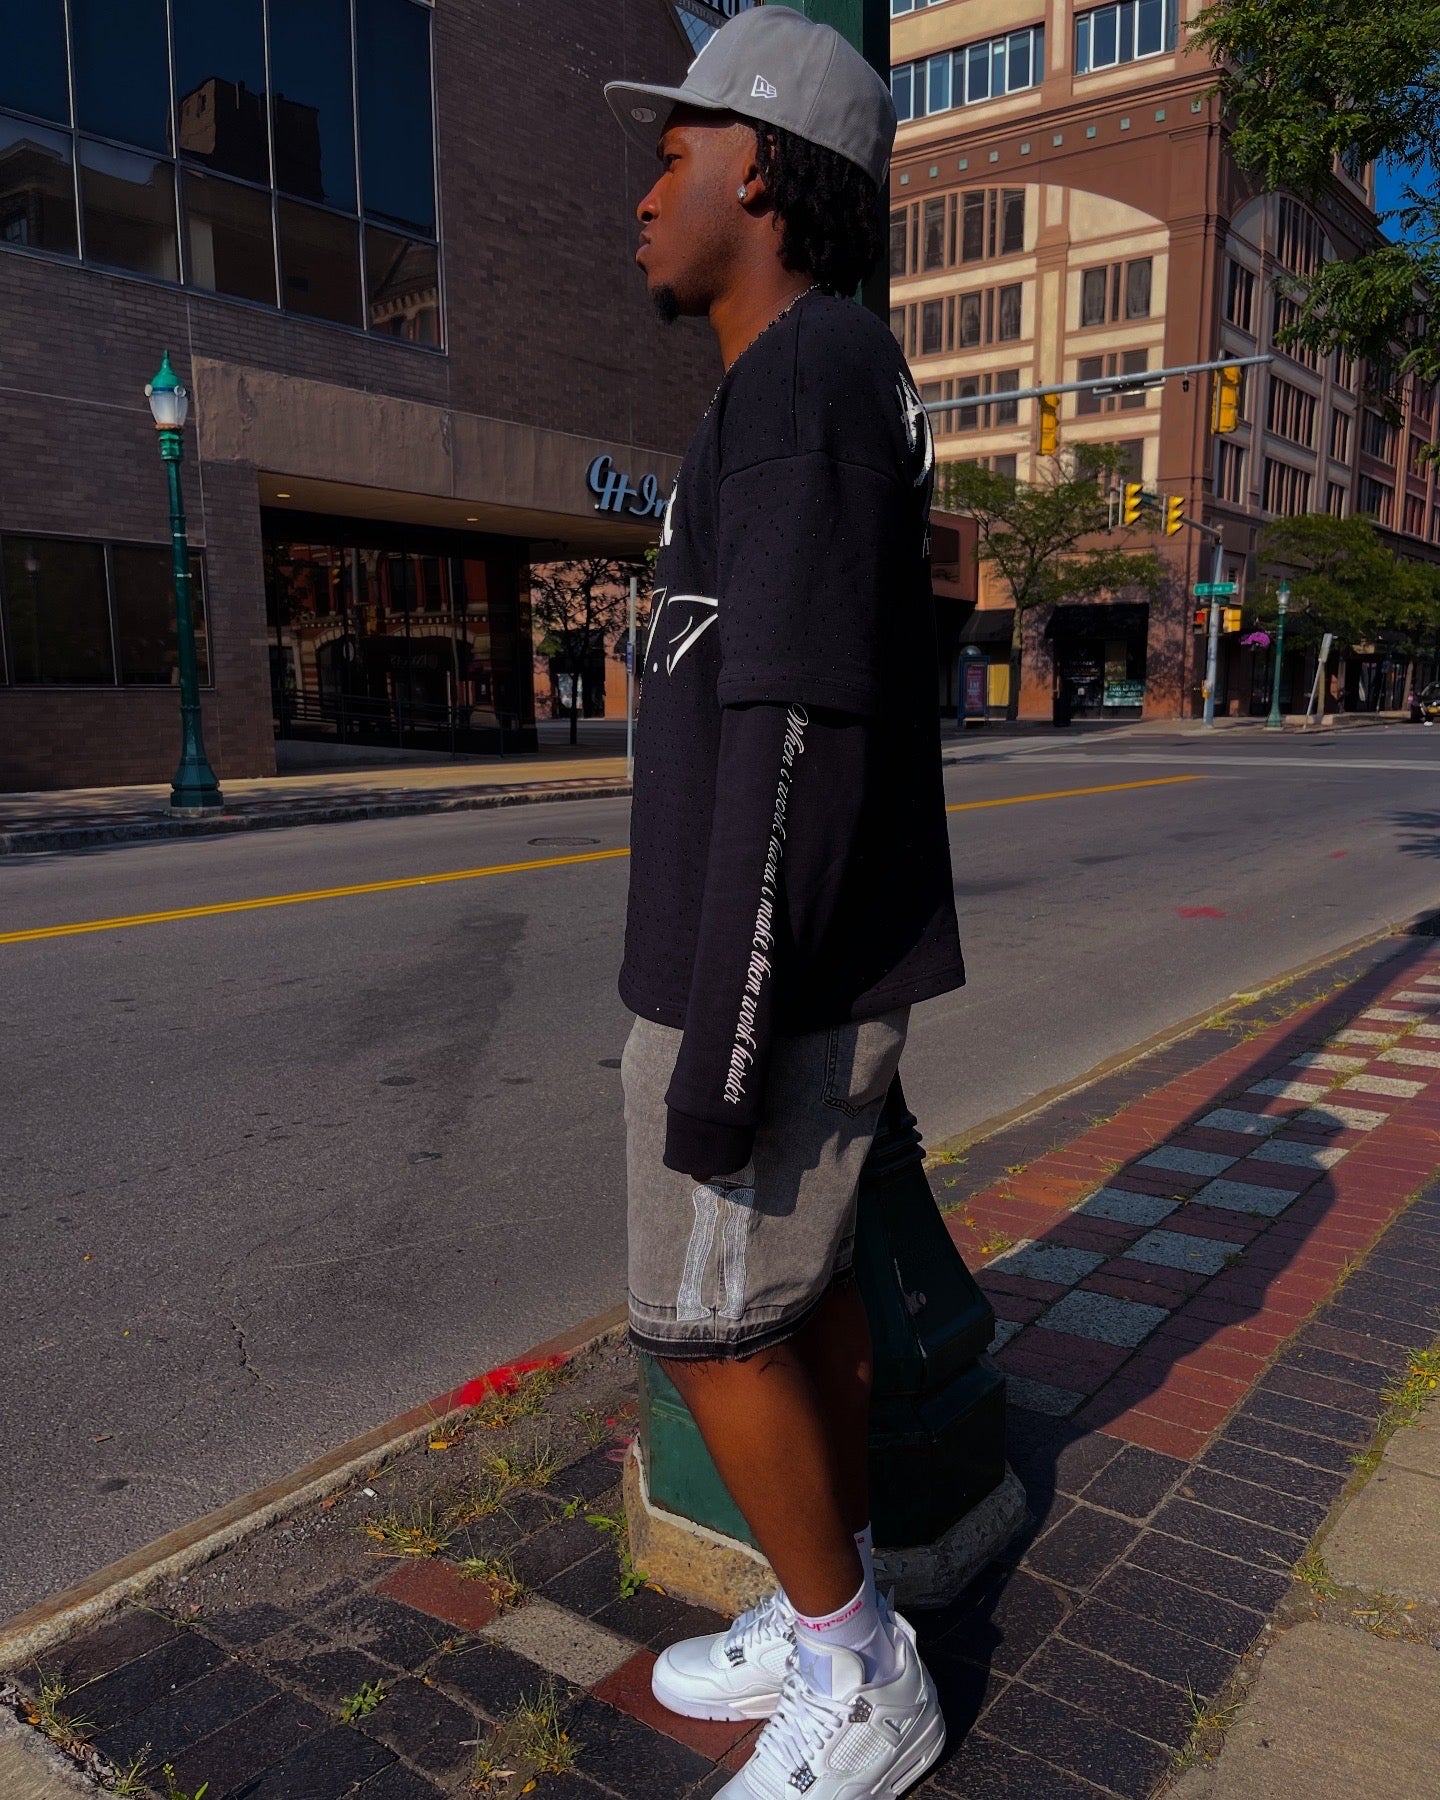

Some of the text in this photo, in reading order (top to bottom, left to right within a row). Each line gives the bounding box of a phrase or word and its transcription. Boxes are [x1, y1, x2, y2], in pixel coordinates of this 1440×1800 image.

[783, 703, 809, 766] When
[773, 781, 789, 840] work
[763, 836, 782, 888] hard
[753, 897, 775, 950] make
[745, 951, 772, 996] them
[735, 995, 757, 1050] work
[723, 1043, 753, 1105] harder
[796, 1601, 863, 1632] Supreme
